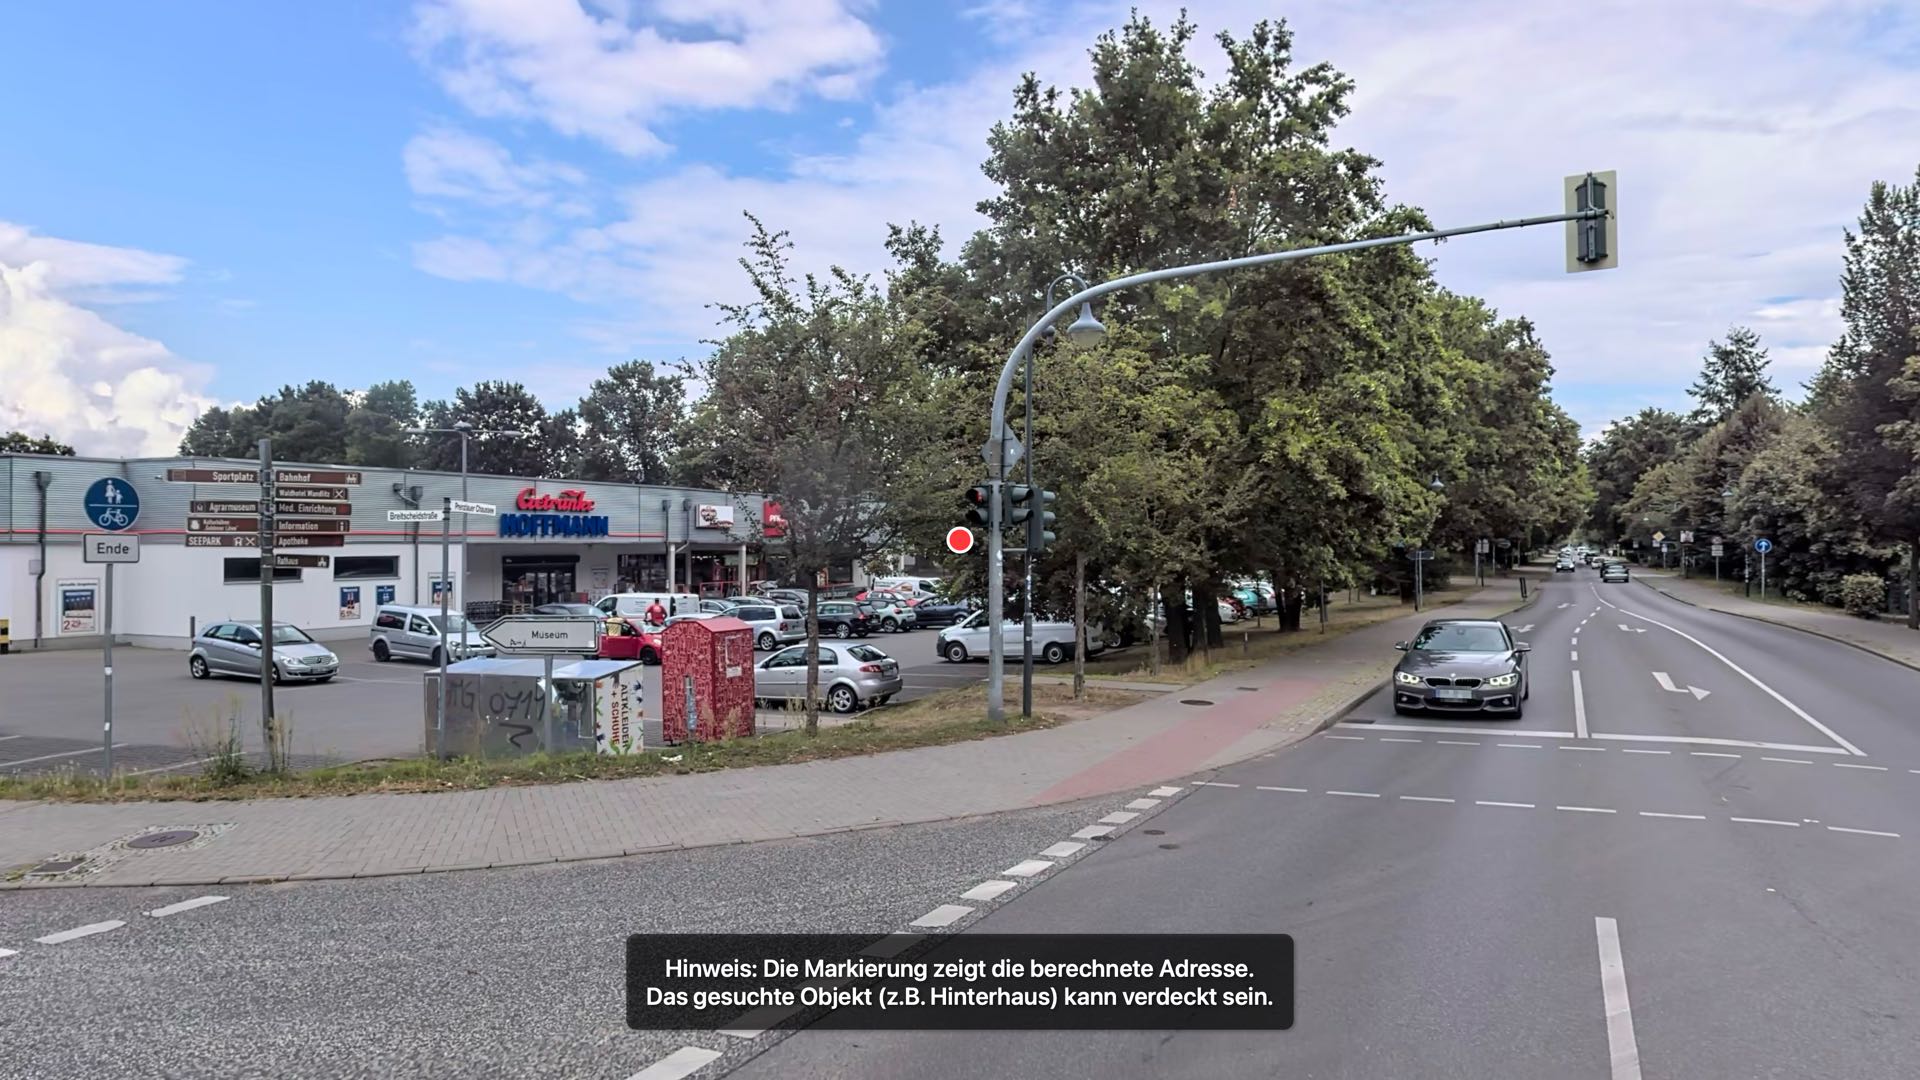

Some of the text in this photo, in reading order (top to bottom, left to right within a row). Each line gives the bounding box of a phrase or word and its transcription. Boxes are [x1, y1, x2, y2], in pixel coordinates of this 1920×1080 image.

[212, 471, 254, 483] Sportplatz
[279, 473, 311, 482] Bahnhof
[516, 487, 597, 512] Getränke
[209, 502, 256, 513] Agrarmuseum
[278, 503, 337, 515] Med. Einrichtung
[389, 511, 438, 521] Breitscheidstraße
[278, 521, 319, 531] Information
[501, 513, 609, 537] HOFFMANN
[188, 536, 221, 545] SEEPARK
[278, 537, 308, 546] Apotheke
[97, 543, 129, 555] Ende
[277, 556, 299, 565] Rathaus
[531, 630, 568, 639] Museum
[620, 684, 630, 748] ALTKLEIDER
[611, 701, 620, 745] SCHUHE
